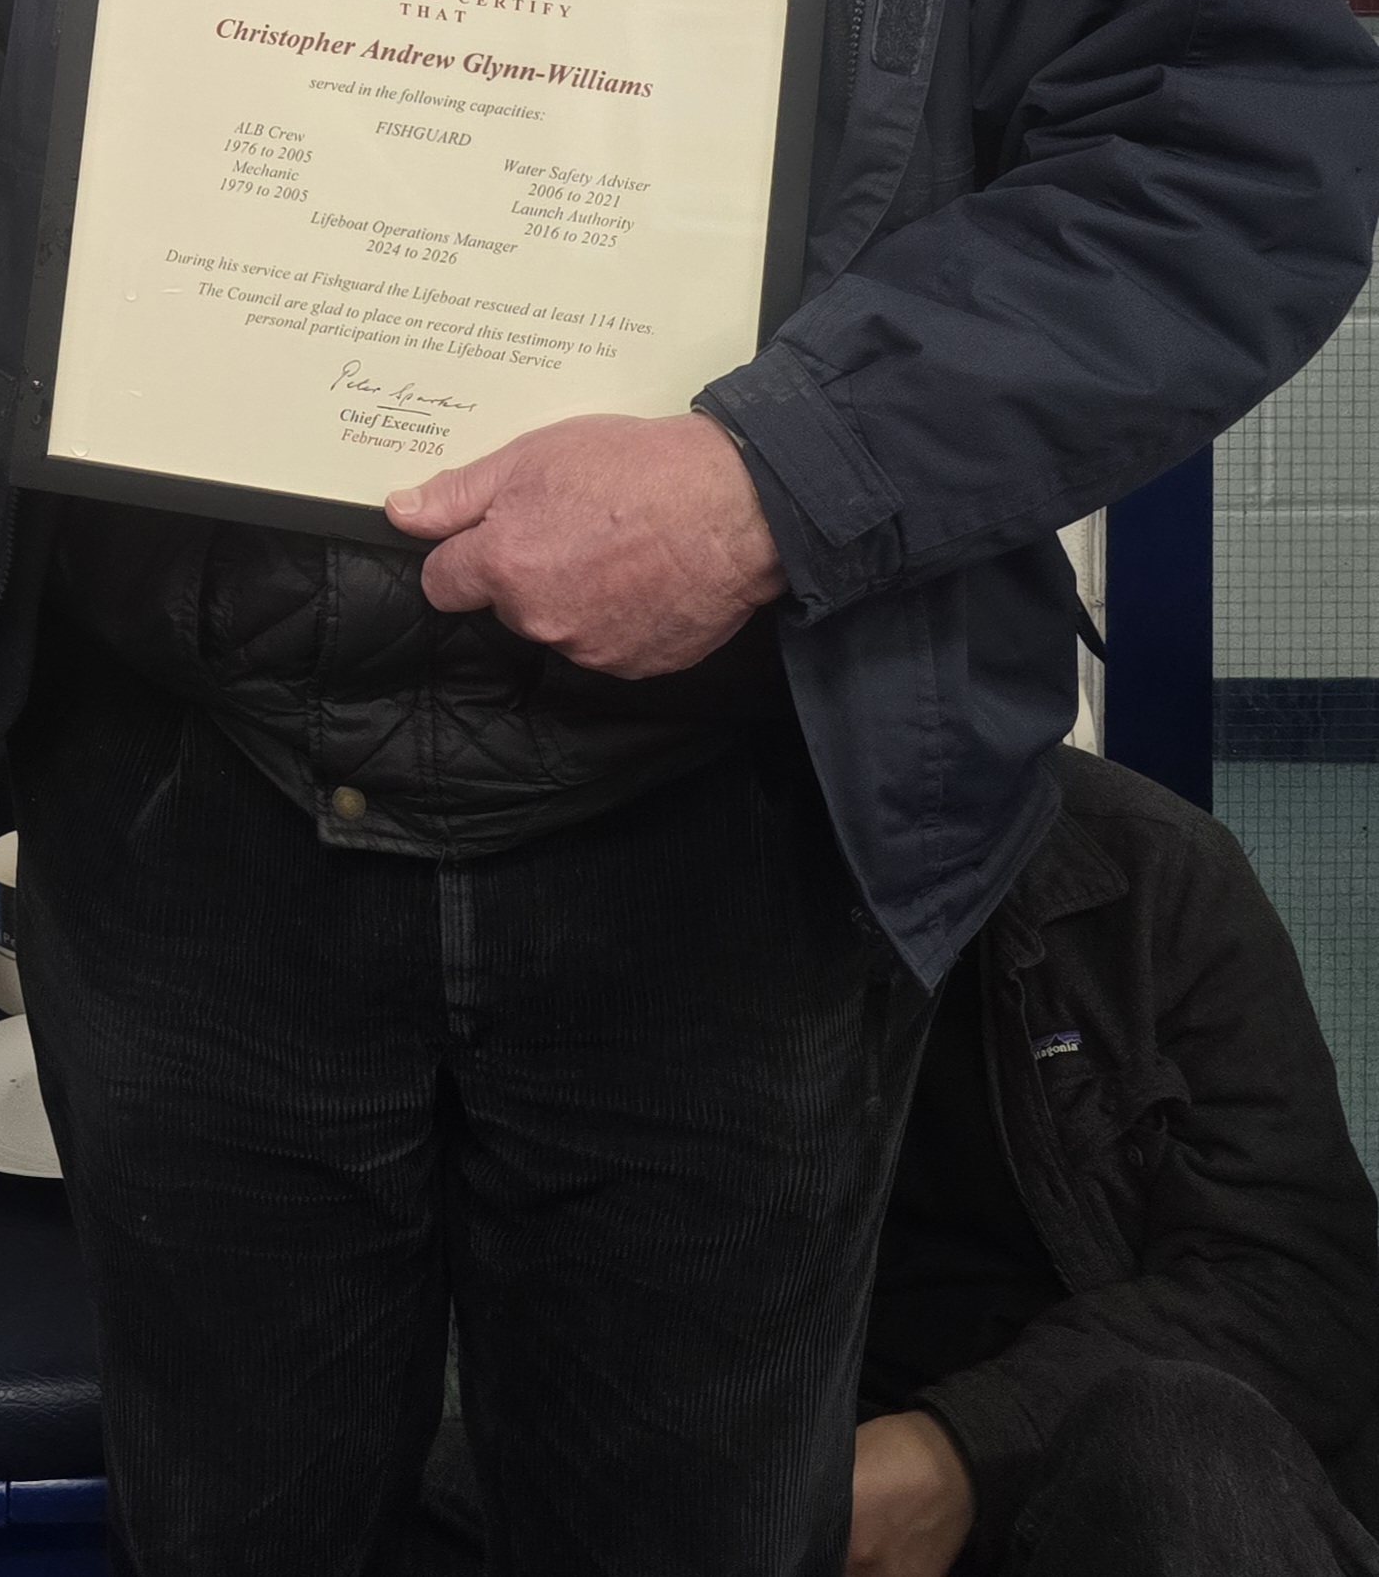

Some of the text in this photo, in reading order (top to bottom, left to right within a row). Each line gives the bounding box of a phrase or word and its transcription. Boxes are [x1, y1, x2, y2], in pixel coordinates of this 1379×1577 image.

[399, 1, 468, 24] THAT
[215, 16, 654, 98] Christopher Andrew Glynn-Williams
[308, 76, 546, 123] served in the following capacities:
[233, 121, 306, 143] ALB Crew
[375, 121, 473, 147] FISHGUARD
[223, 138, 314, 164] 1976 to 2005
[231, 159, 300, 182] Mechanic
[503, 158, 651, 193] Water Safety Adviser
[219, 177, 310, 203] 1979 to 2005
[527, 183, 621, 209] 2006 to 2021
[510, 200, 635, 234] Launch Authority
[310, 211, 518, 255] Lifeboat Operations Manager
[524, 222, 618, 248] 2016 to 2025
[366, 239, 459, 265] 2024 to 2026
[164, 249, 656, 336] During his service at Fishguard the Lifeboat rescued at least 114 lives.
[197, 282, 618, 359] The Council are glad to place on record this testimony to his
[244, 312, 562, 370] personal participation in the Lifeboat Service
[339, 408, 451, 438] Chief Executive
[341, 428, 445, 457] February 2026
